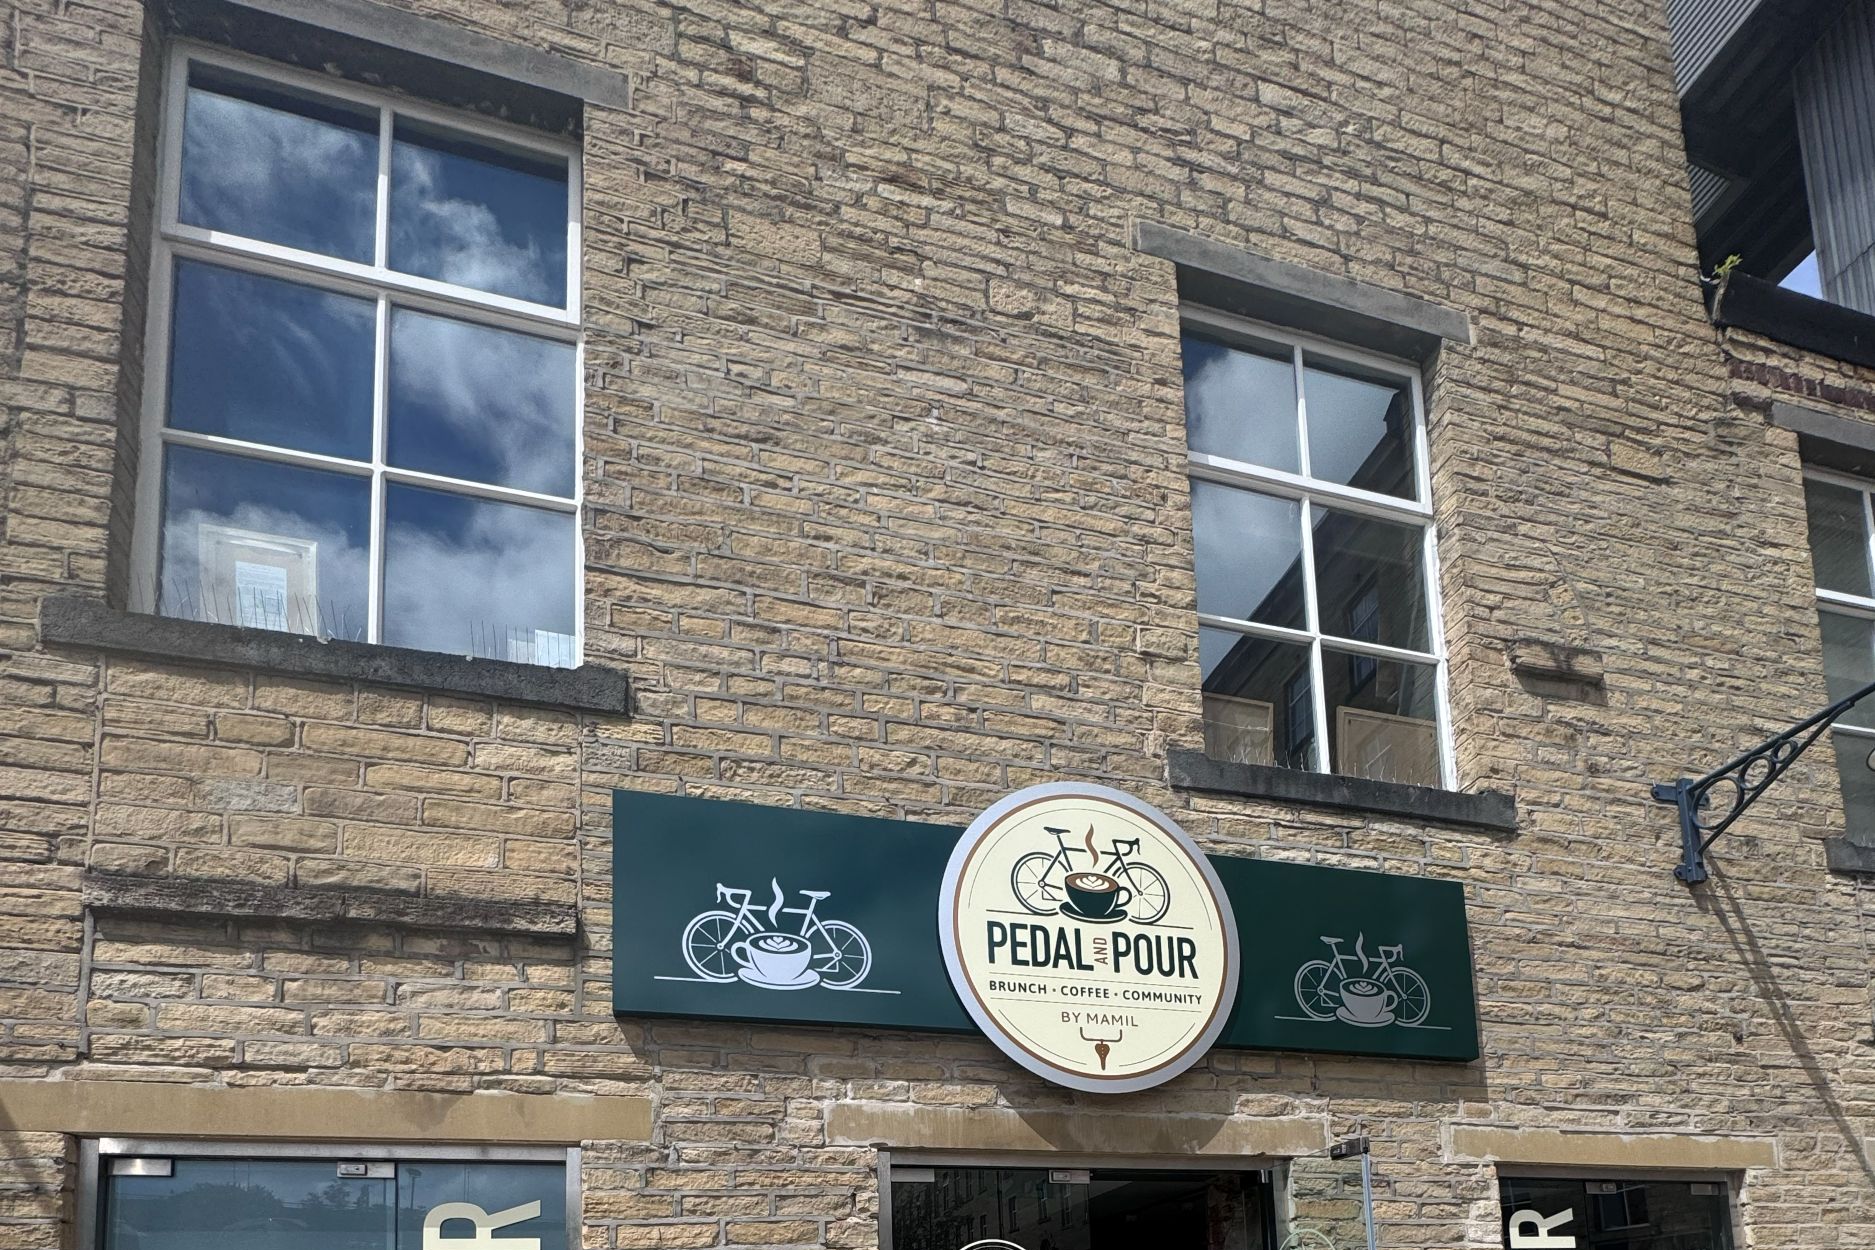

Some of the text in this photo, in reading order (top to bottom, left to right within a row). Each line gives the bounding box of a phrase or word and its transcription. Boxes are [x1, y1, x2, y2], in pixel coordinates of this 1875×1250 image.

[987, 920, 1199, 979] PEDAL AND POUR
[989, 980, 1202, 1005] BRUNCH COFFEE COMMUNITY
[1061, 1012, 1139, 1027] BY MAMIL
